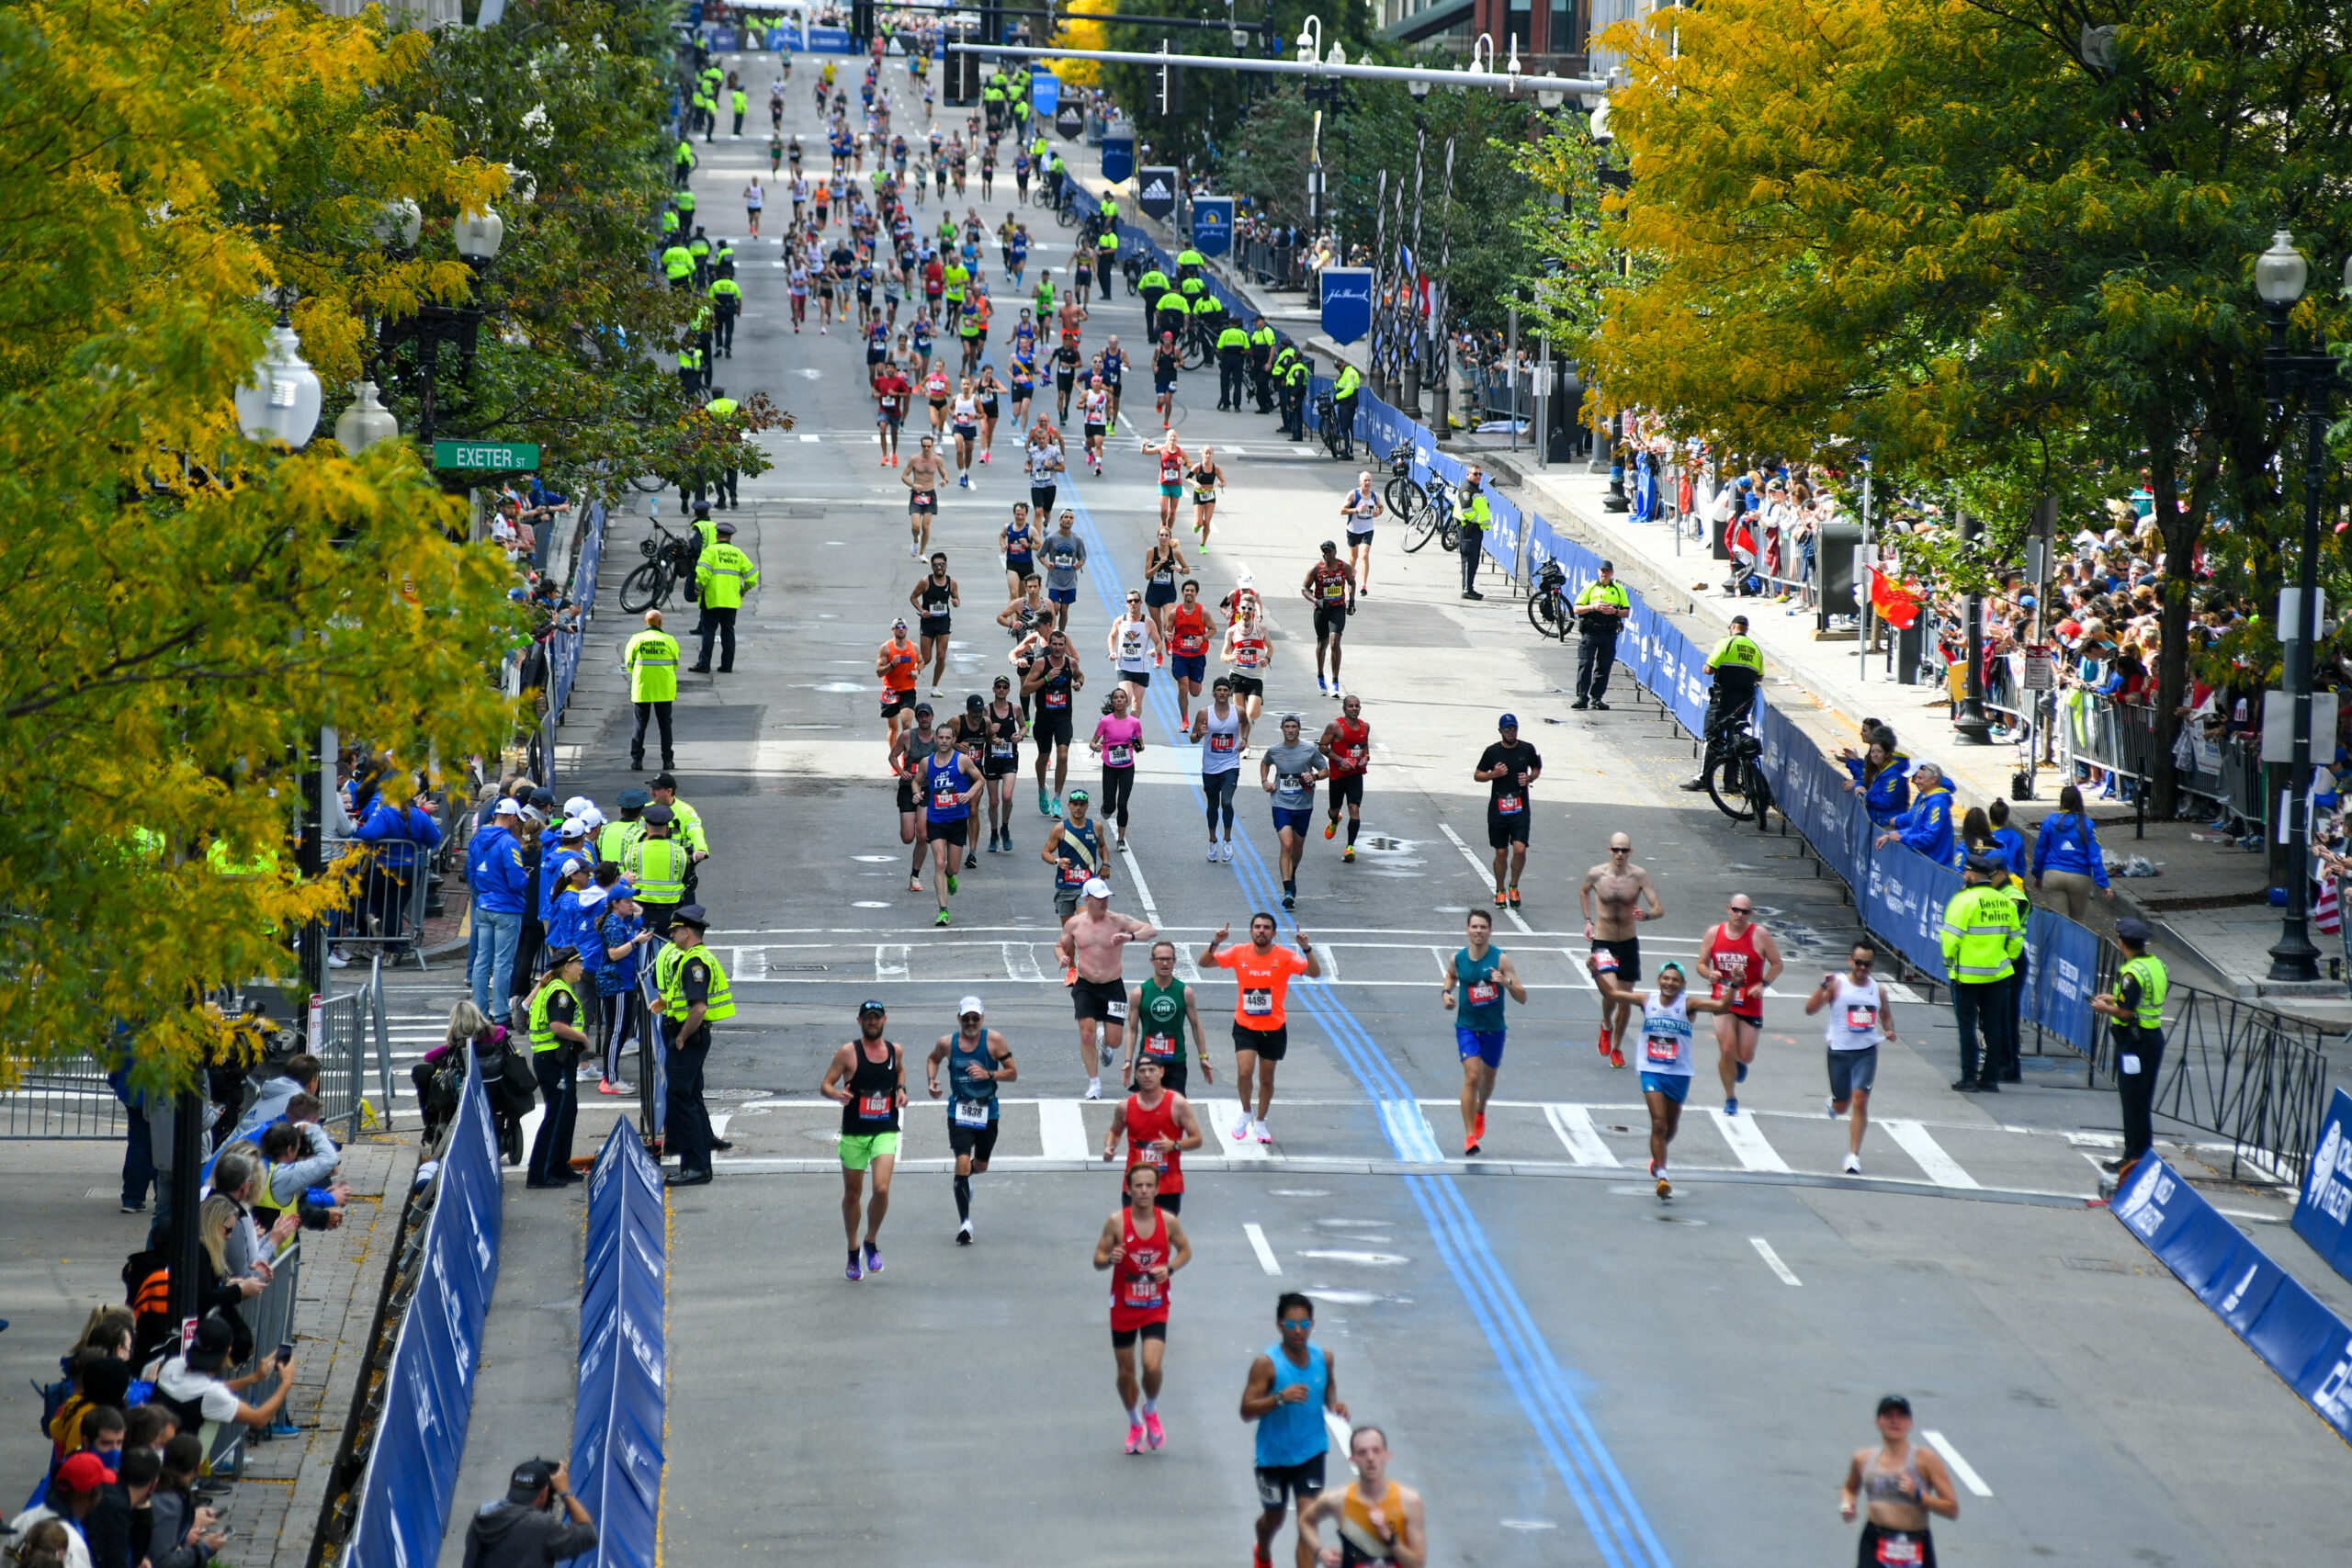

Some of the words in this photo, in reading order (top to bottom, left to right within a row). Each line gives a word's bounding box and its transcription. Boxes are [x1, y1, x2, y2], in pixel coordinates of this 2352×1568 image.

[1141, 190, 1172, 200] adidas
[1323, 288, 1344, 304] John
[457, 447, 512, 468] EXETER
[515, 457, 526, 468] ST
[718, 549, 739, 558] Boston
[718, 557, 738, 565] Police
[1323, 575, 1342, 583] KENYA
[1327, 586, 1342, 595] GUIDE
[639, 646, 666, 655] Police
[1736, 644, 1756, 655] BOSTON
[1738, 652, 1754, 662] POLICE
[1979, 897, 2009, 910] Boston
[1981, 910, 2011, 923] Police
[1716, 953, 1748, 963] TEAM
[1247, 996, 1267, 1007] 4495
[961, 1105, 983, 1119] 5838
